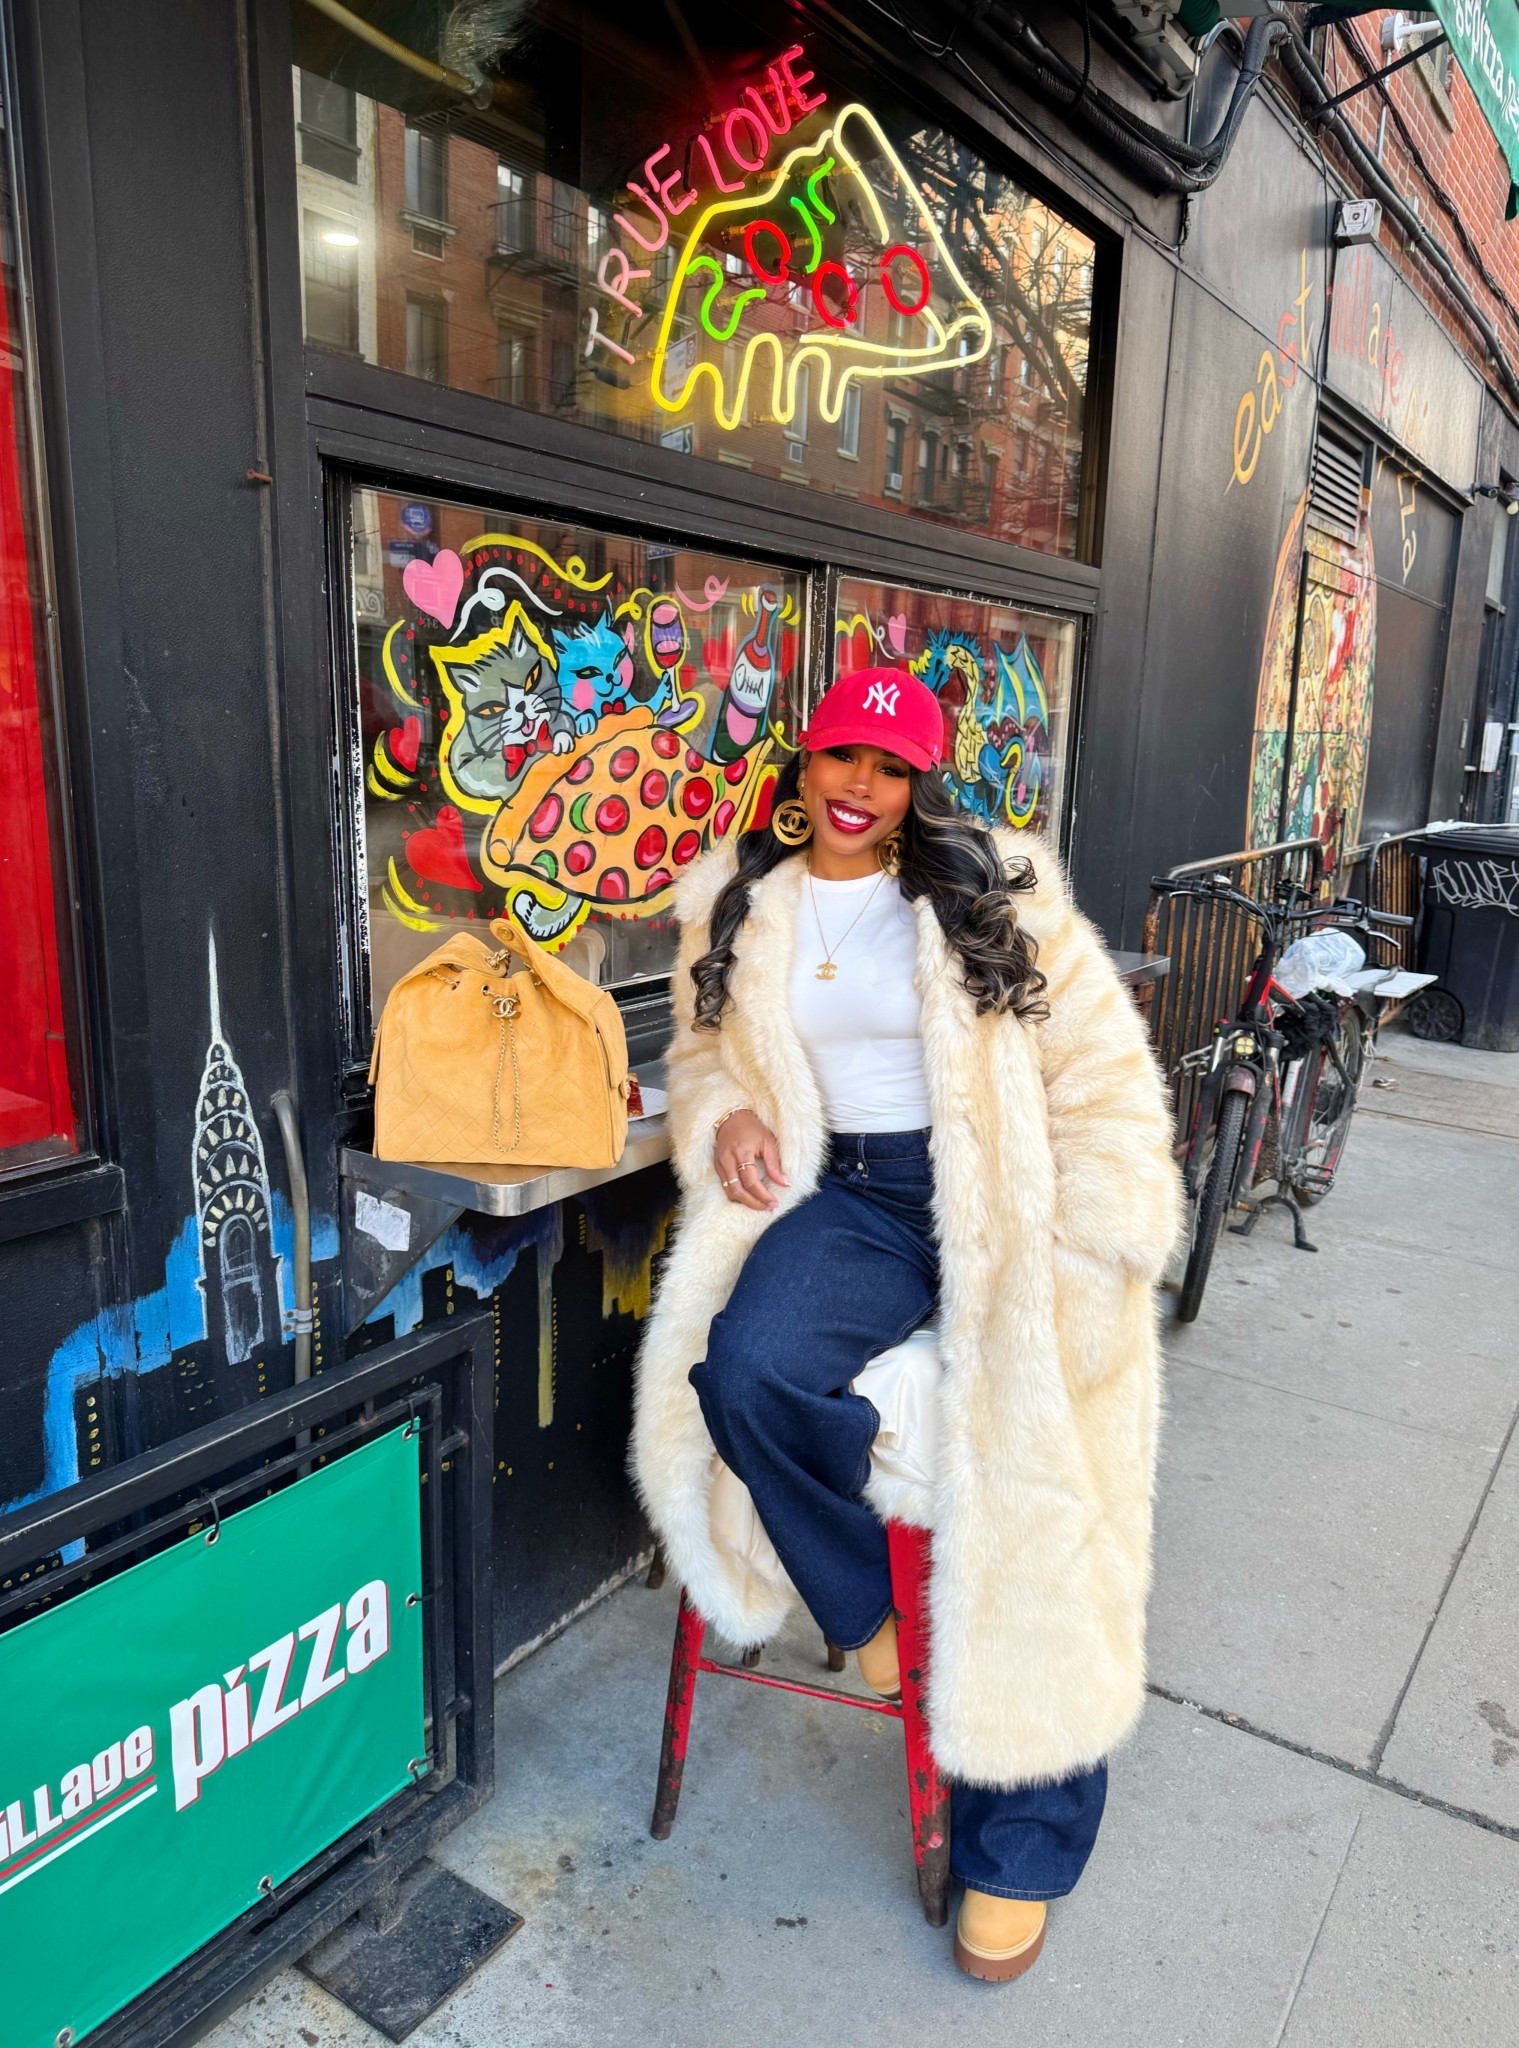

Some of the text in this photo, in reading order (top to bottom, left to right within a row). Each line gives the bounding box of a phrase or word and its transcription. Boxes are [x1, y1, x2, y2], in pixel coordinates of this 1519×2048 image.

[585, 45, 828, 365] TRUE LOVE
[1223, 247, 1314, 496] east
[862, 681, 901, 717] NY
[169, 1579, 390, 1812] pizza
